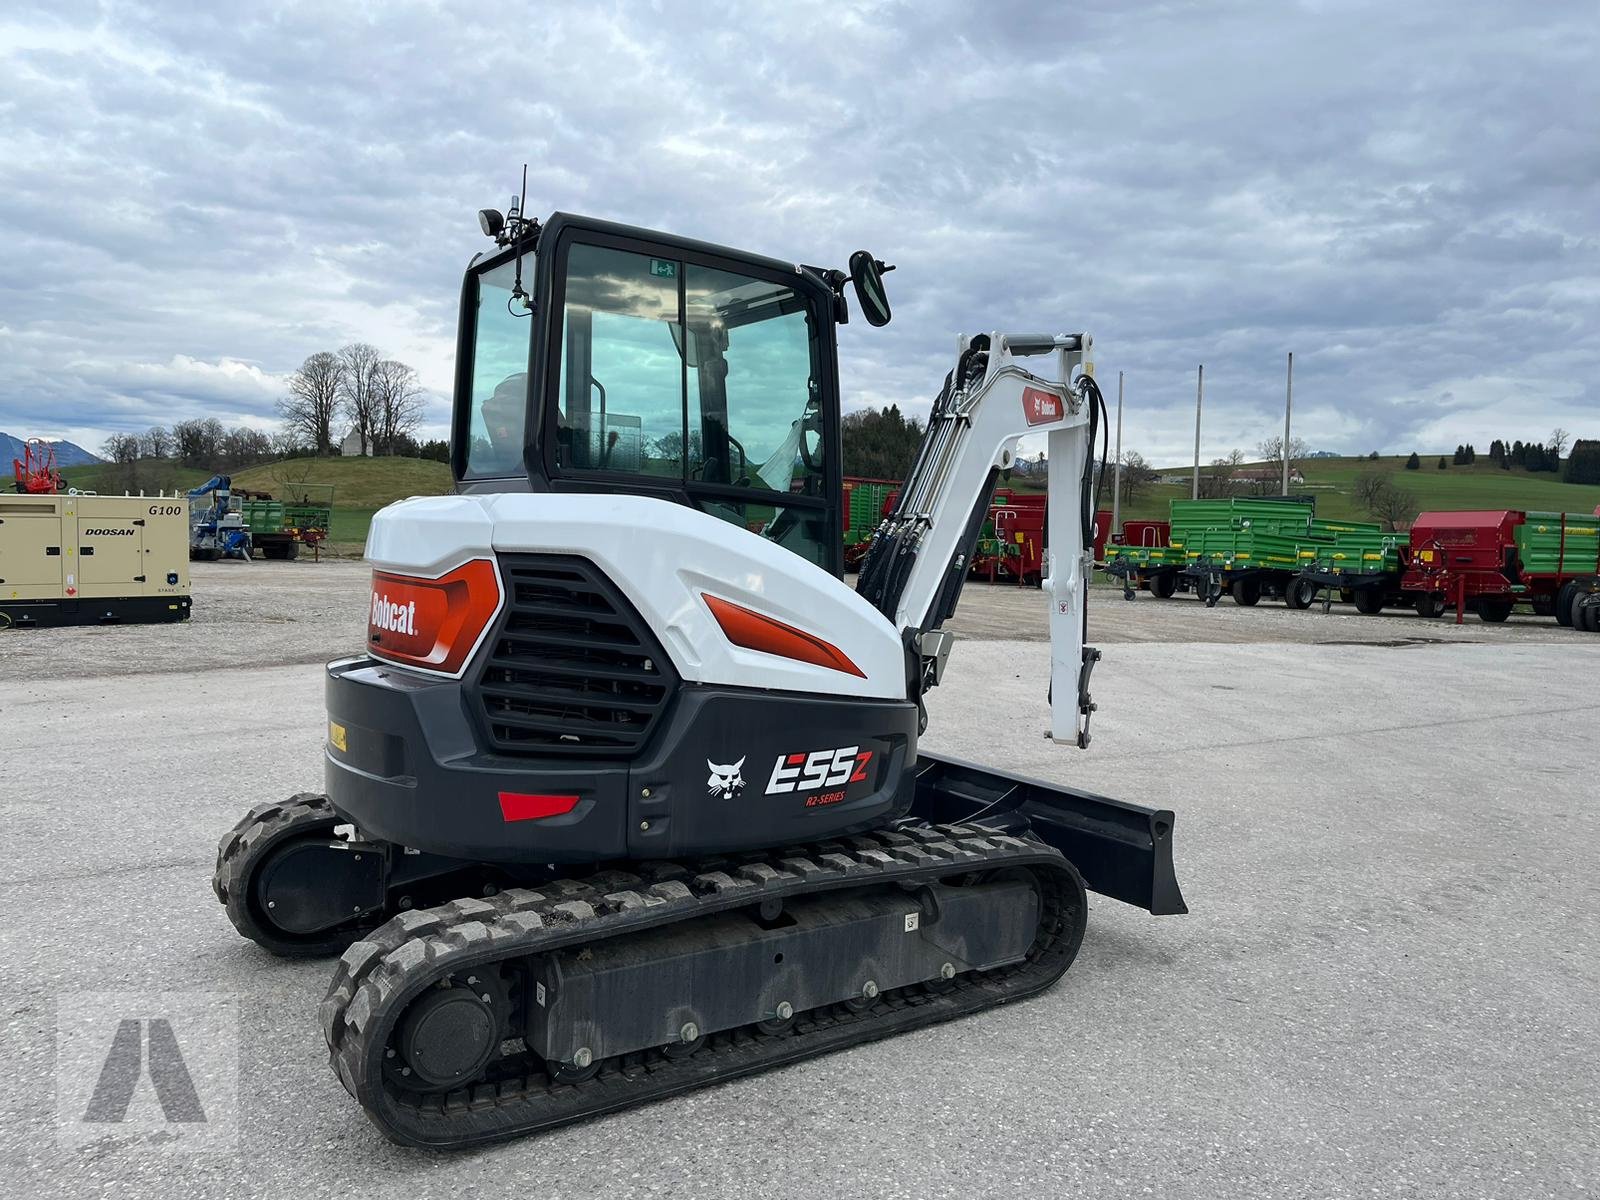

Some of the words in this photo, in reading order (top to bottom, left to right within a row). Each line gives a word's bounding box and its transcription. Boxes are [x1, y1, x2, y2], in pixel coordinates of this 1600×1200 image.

[148, 505, 182, 516] G100
[85, 528, 135, 536] DOOSAN
[372, 592, 415, 635] Bobcat
[805, 791, 846, 806] R2-SERIES
